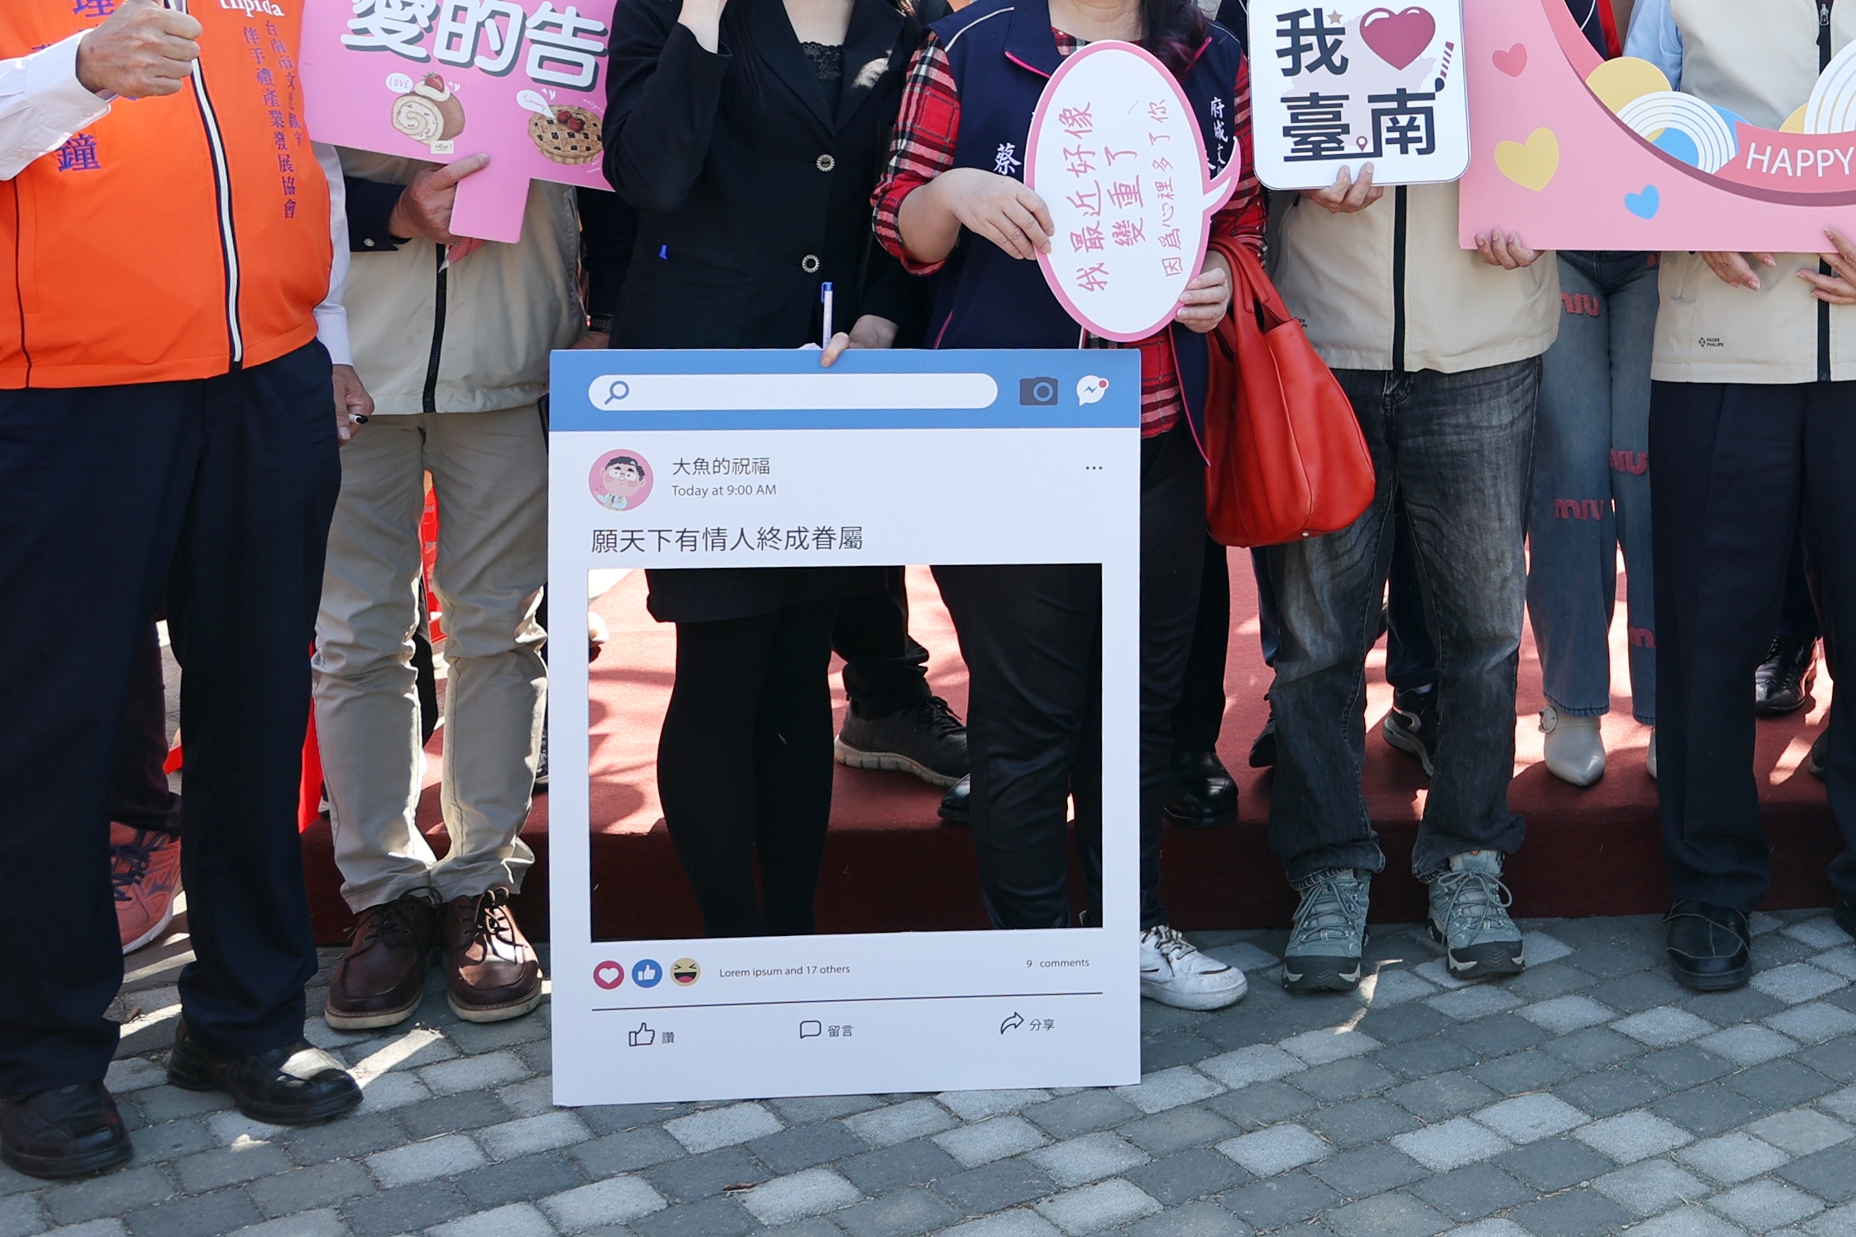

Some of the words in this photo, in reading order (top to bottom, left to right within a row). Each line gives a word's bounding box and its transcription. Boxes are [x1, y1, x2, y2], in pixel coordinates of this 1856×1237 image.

[1275, 7, 1349, 77] 我
[388, 76, 410, 90] LOVE
[243, 26, 297, 220] 伴手禮產業發展協會
[1280, 87, 1437, 163] 臺南
[1745, 141, 1855, 178] HAPPY
[1057, 101, 1110, 292] 我最近好像
[1104, 145, 1146, 248] 變重了
[672, 456, 770, 476] 大魚的祝福
[671, 484, 708, 498] Today
[711, 485, 724, 496] at
[727, 484, 753, 496] 9:00
[755, 484, 777, 496] AM
[591, 524, 864, 554] 願天下有情人終成眷屬
[719, 968, 751, 978] Lorem
[752, 967, 783, 979] ipsum
[785, 966, 803, 976] and
[806, 966, 817, 975] 17
[819, 965, 851, 975] others
[1026, 959, 1033, 968] 9
[1039, 958, 1090, 968] comments
[827, 1024, 854, 1038] 留言
[1029, 1018, 1056, 1032] 分享
[661, 1031, 676, 1045] 讚
